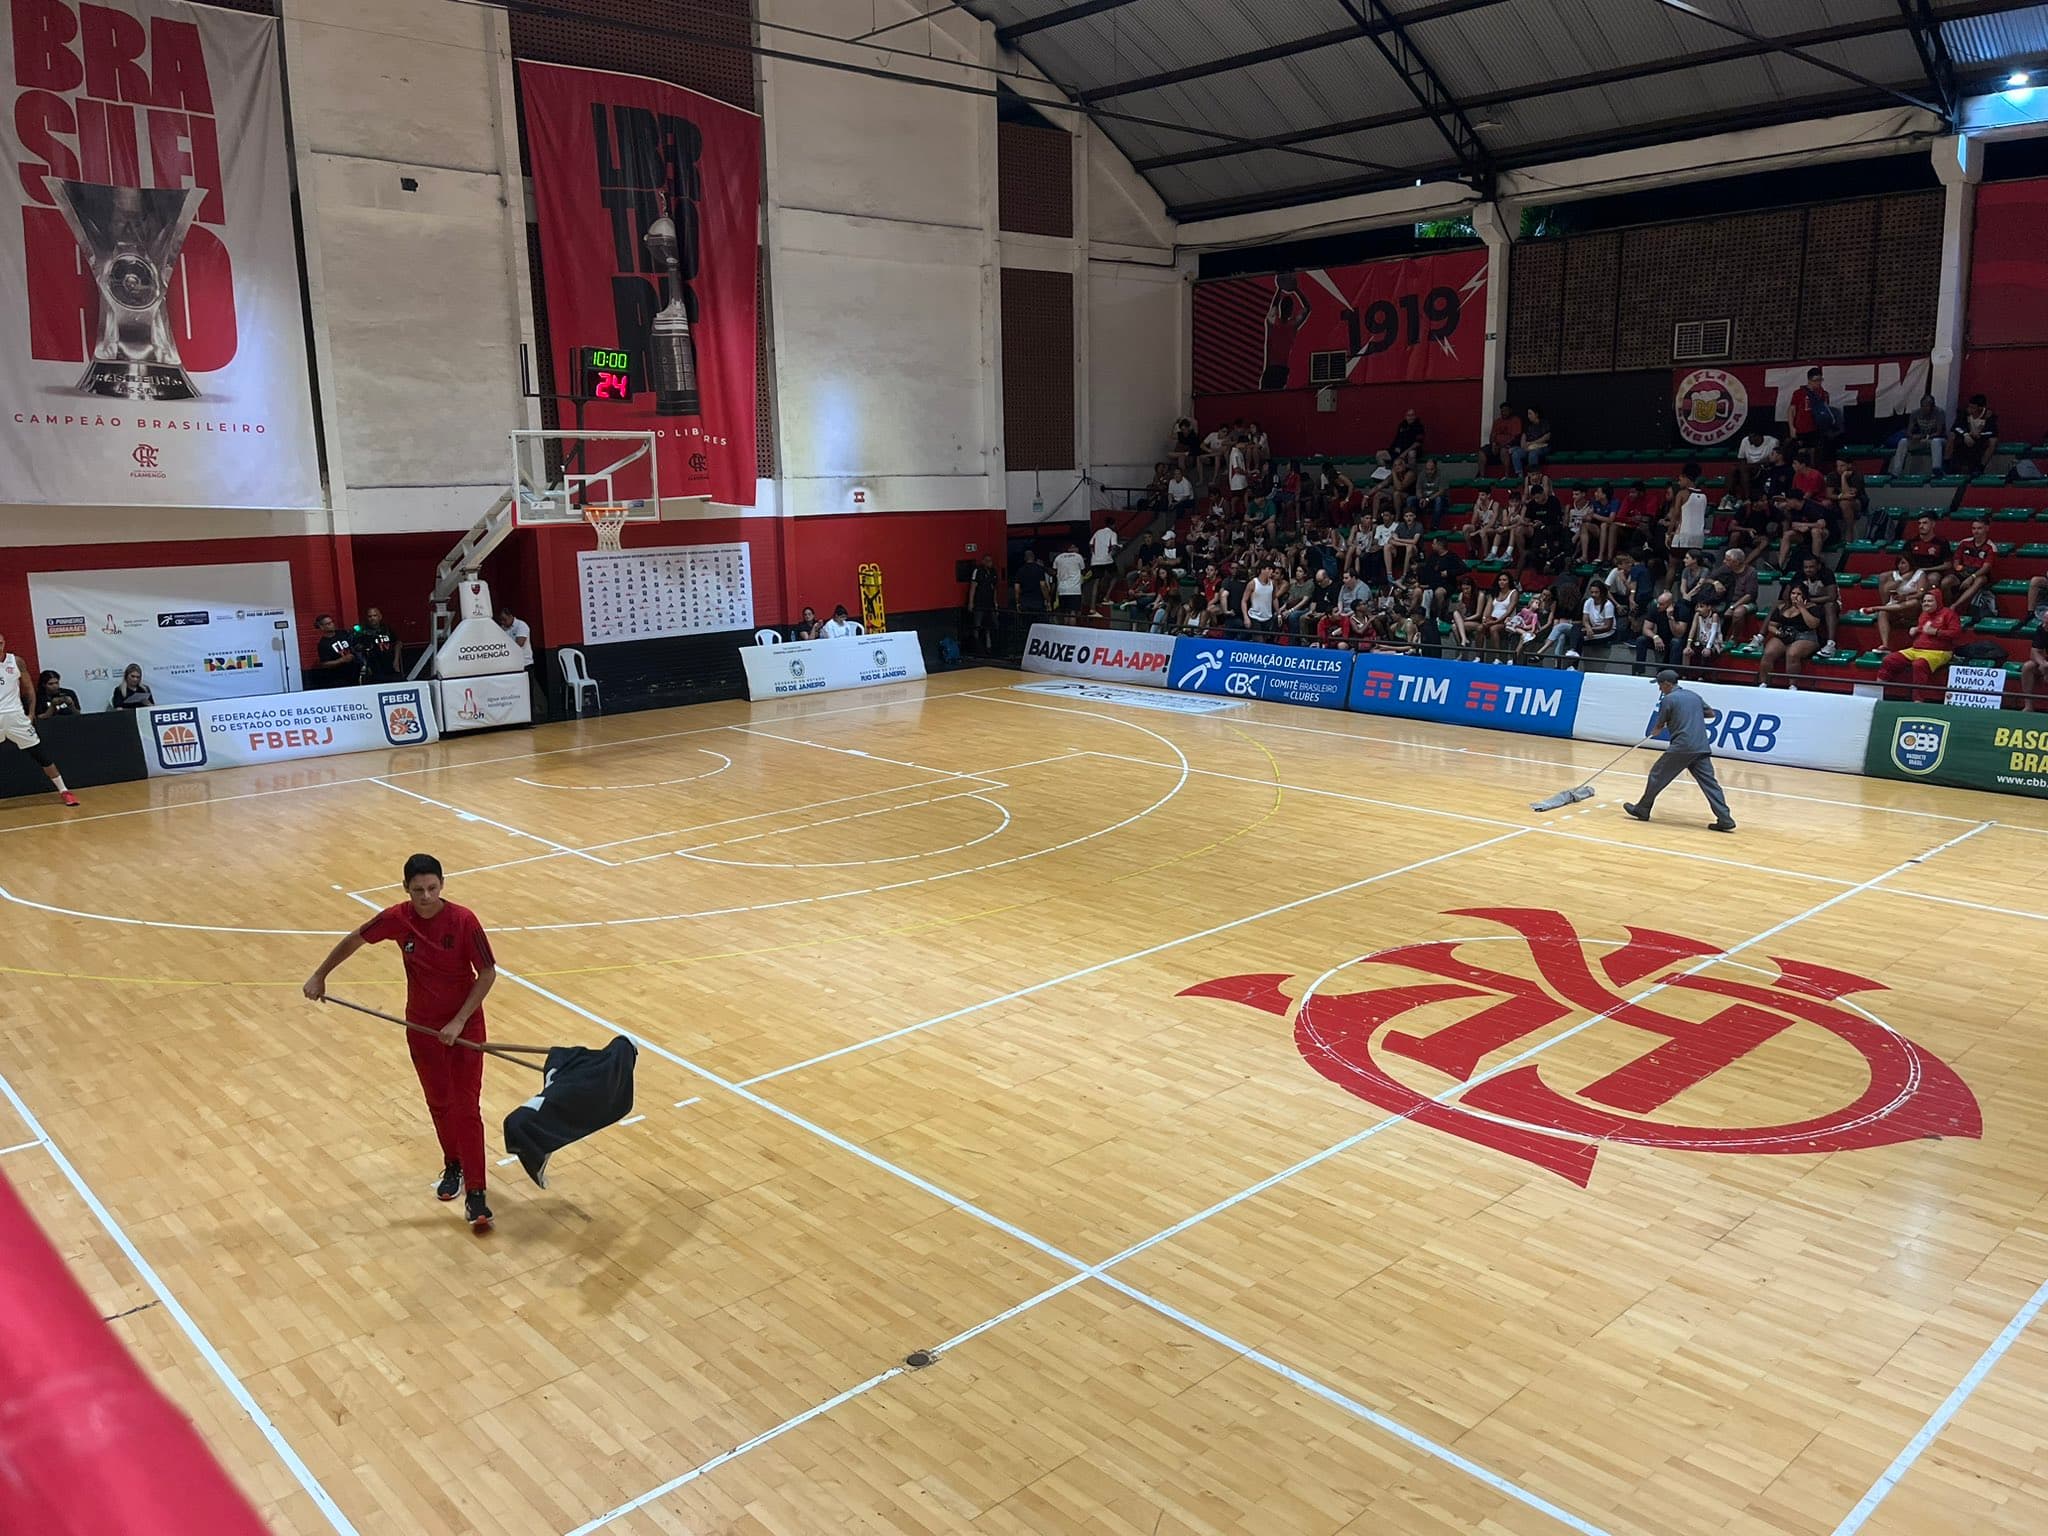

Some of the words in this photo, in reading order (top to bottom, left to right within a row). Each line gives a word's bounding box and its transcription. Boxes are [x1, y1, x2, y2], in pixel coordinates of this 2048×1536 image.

[11, 0, 215, 115] BRA
[1340, 286, 1460, 357] 1919
[593, 351, 627, 369] 10:00
[596, 372, 627, 398] 24
[14, 413, 121, 427] CAMPEÃO
[138, 418, 266, 434] BRASILEIRO
[1028, 638, 1075, 662] BAIXE
[1077, 646, 1090, 663] O
[1091, 647, 1170, 673] FLA-APP!
[1230, 652, 1283, 668] FORMAÇÃO
[1284, 656, 1297, 669] DE
[1298, 659, 1342, 672] ATLETAS
[882, 670, 907, 679] JANEIRO
[1954, 676, 1985, 686] RUMO
[1987, 679, 1995, 687] A
[1956, 668, 1999, 678] MENGÃO
[788, 684, 797, 692] DE
[798, 681, 826, 690] JANEIRO
[1225, 672, 1260, 696] CBC
[1270, 678, 1299, 690] COMITÊ
[1300, 682, 1338, 693] BRASILEIRO
[1398, 674, 1450, 705] TIM
[382, 693, 415, 704] FBERJ
[1290, 691, 1320, 702] CLUBES
[1504, 686, 1563, 717] TIM
[154, 711, 194, 724] FBERJ
[211, 709, 277, 722] FEDERAÇÃO
[280, 708, 293, 717] DE
[297, 703, 369, 716] BASQUETEBOL
[211, 724, 227, 733] DO
[230, 720, 272, 731] ESTADO
[275, 718, 291, 727] DO
[294, 716, 311, 726] RIO
[315, 714, 328, 723] DE
[332, 712, 373, 722] JANEIRO
[249, 726, 334, 752] FBERJ
[1899, 731, 1939, 752] CBB
